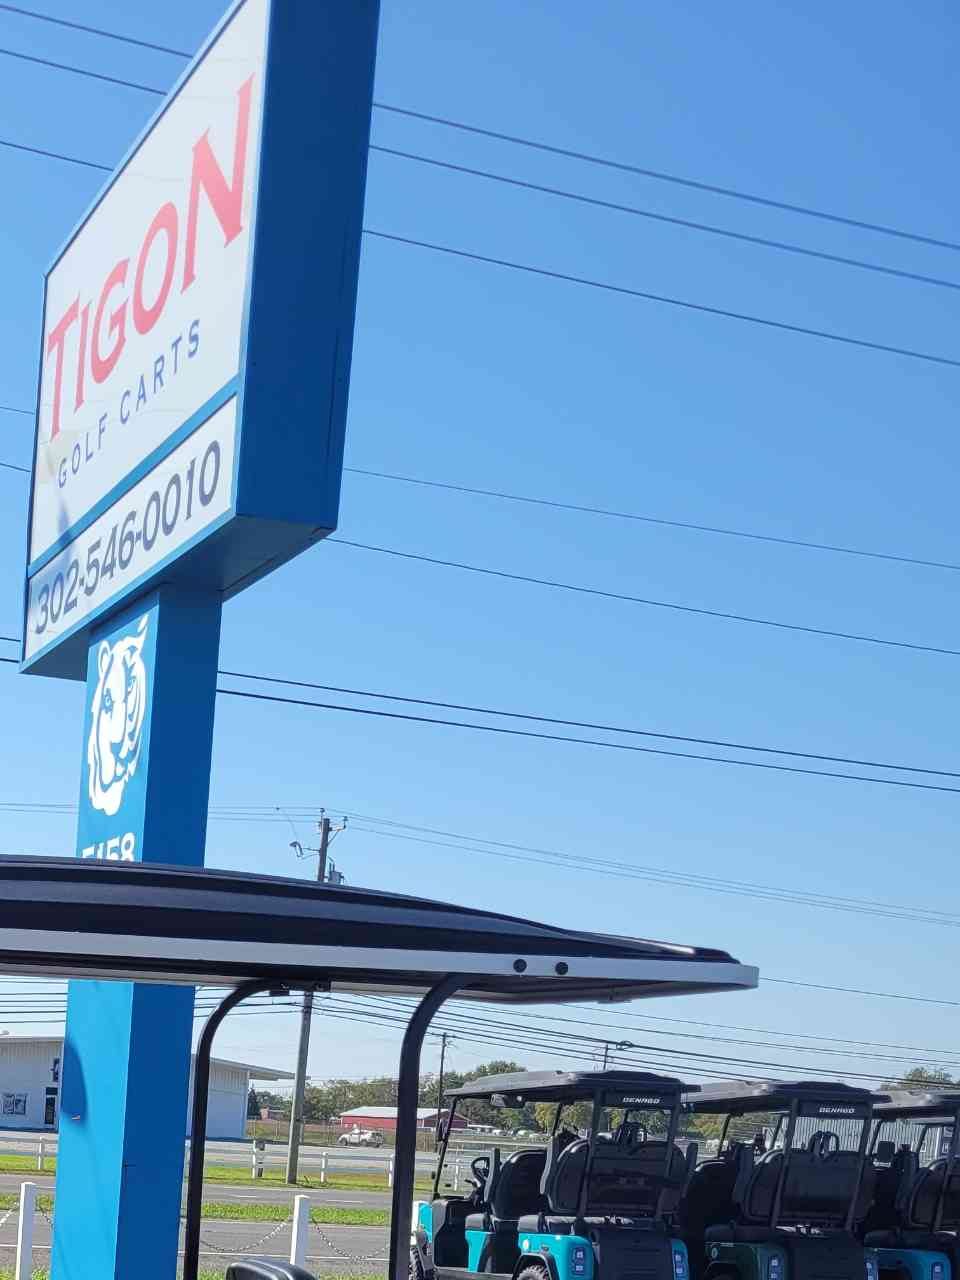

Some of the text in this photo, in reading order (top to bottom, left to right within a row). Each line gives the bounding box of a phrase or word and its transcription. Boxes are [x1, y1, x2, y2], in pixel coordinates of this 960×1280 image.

[46, 70, 255, 441] TIGON
[58, 318, 200, 489] GOLF CARTS
[35, 440, 221, 635] 302-546-0010
